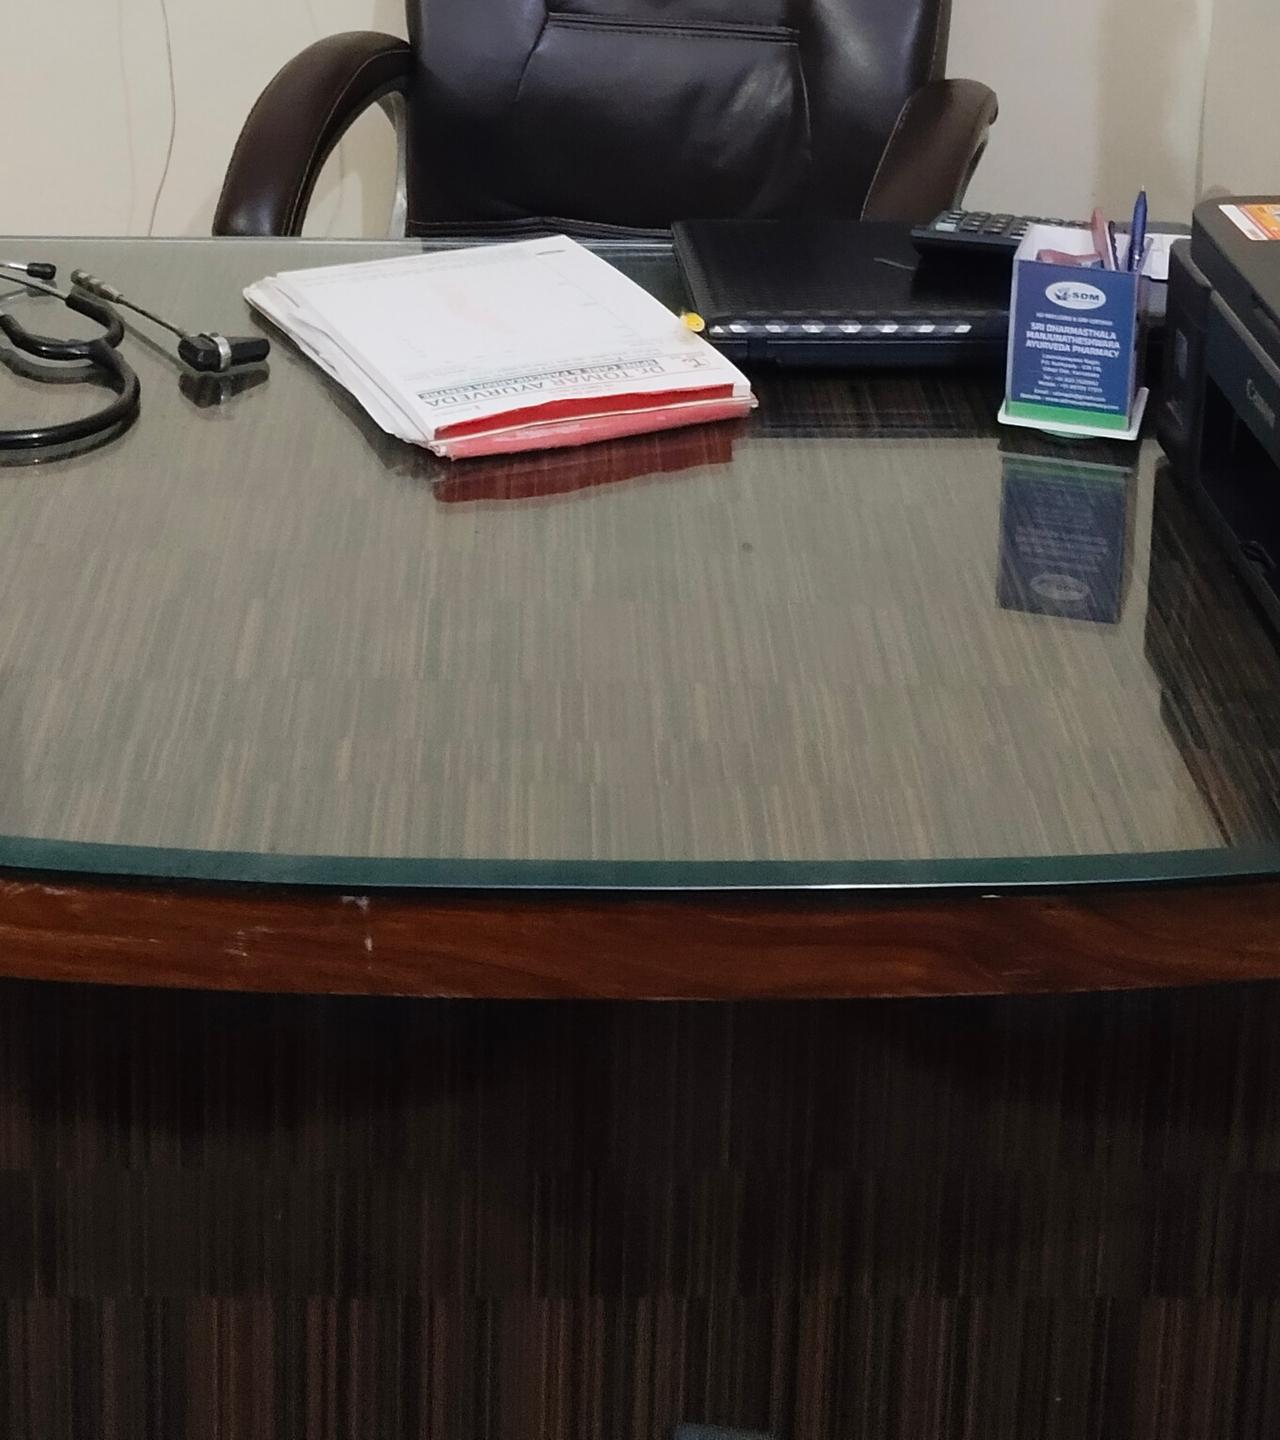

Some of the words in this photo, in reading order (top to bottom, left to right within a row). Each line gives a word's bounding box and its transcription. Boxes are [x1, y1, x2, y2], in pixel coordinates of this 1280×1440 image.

[1072, 291, 1100, 301] SDM
[1071, 344, 1120, 358] PHARMACY
[550, 370, 634, 387] TOMAR
[424, 381, 544, 407] AYURVEDA
